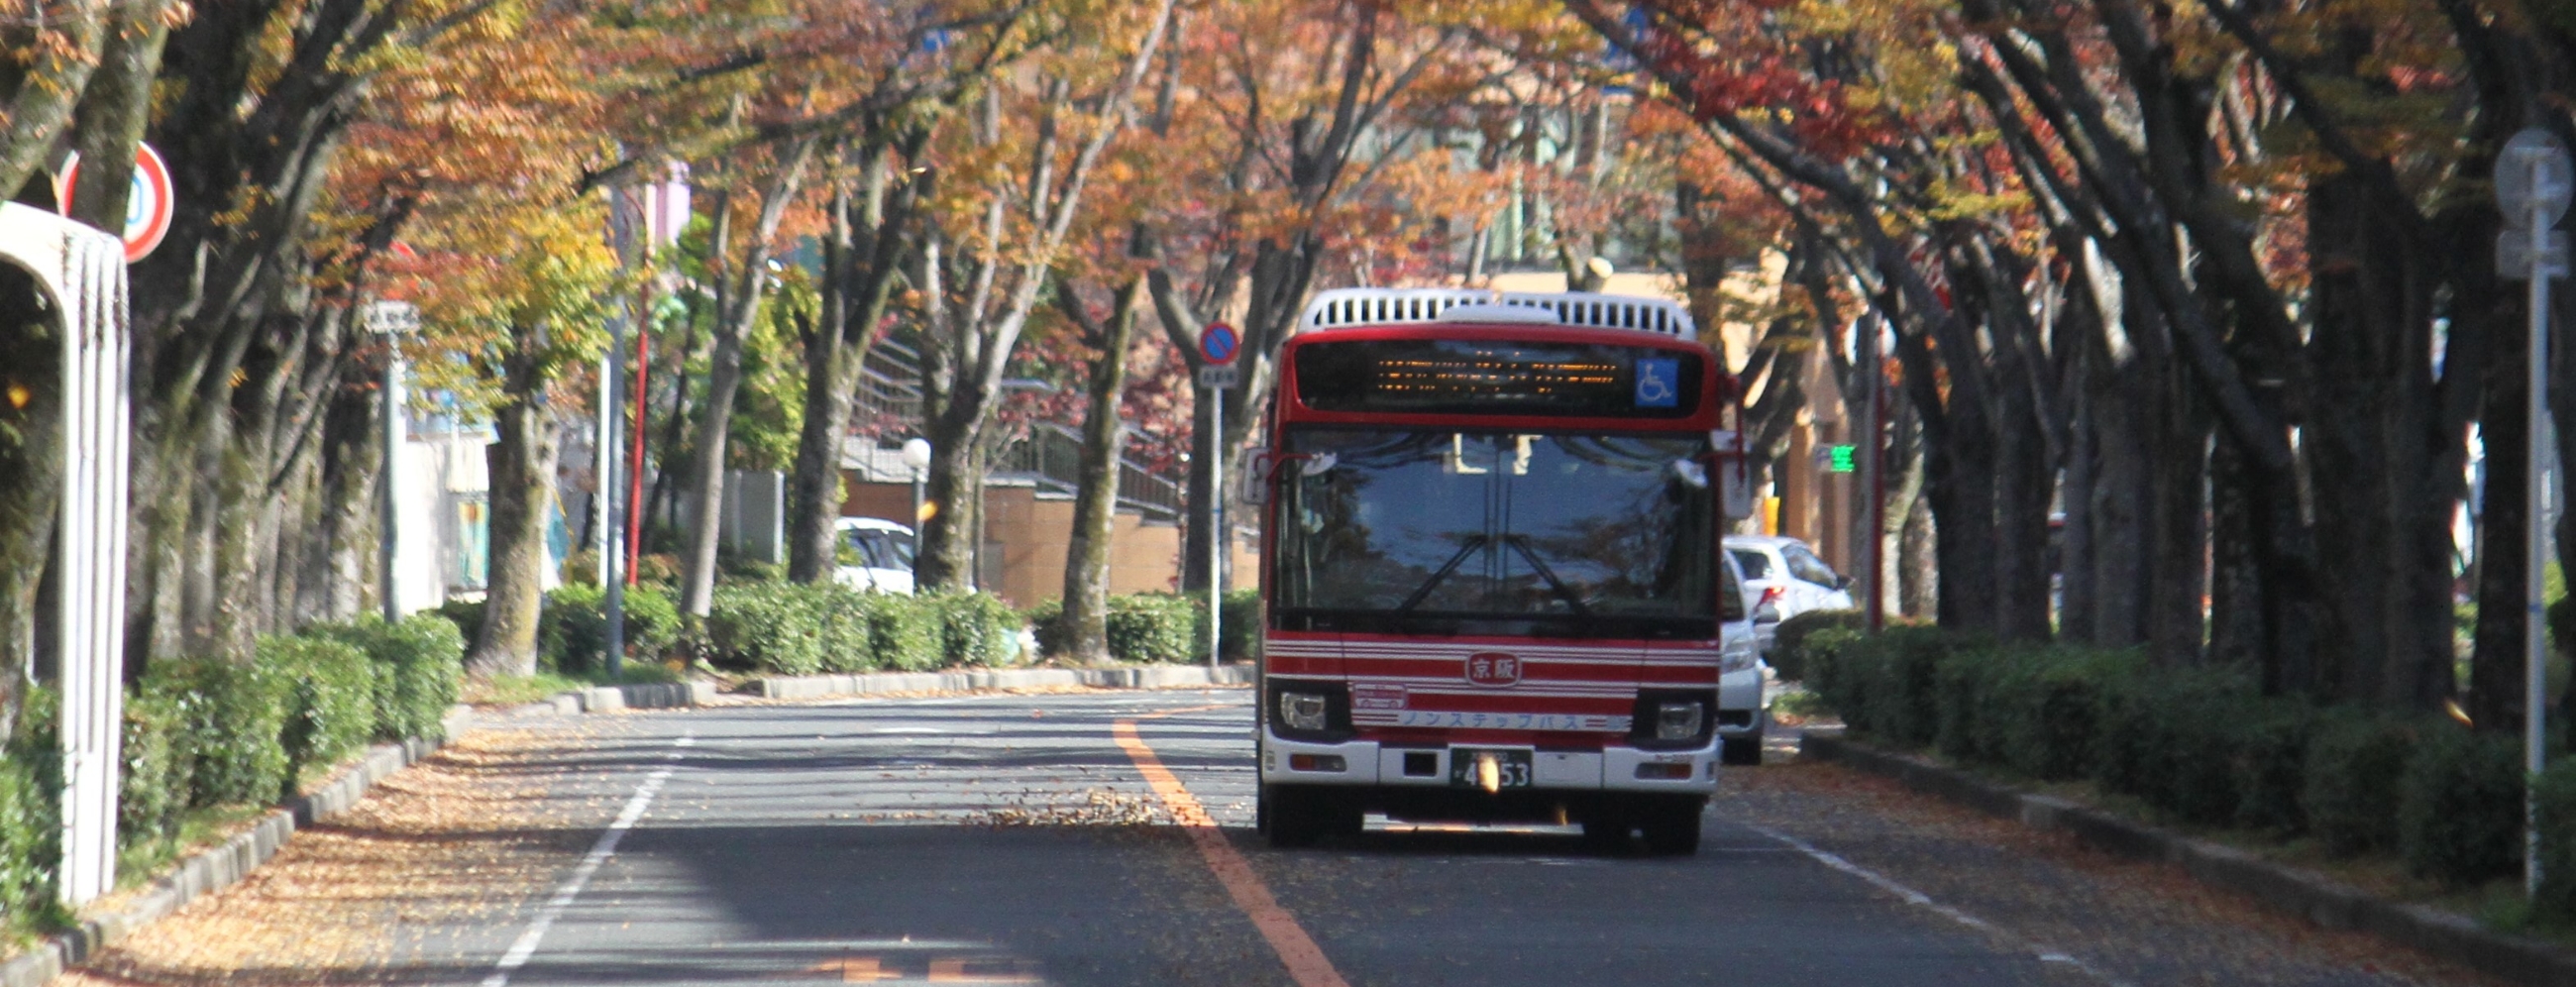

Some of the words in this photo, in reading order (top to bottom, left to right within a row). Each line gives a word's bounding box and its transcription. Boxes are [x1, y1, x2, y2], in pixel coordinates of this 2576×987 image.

[1472, 658, 1515, 679] 京阪
[1404, 713, 1579, 729] ノンステップバス
[1464, 762, 1530, 786] 453
